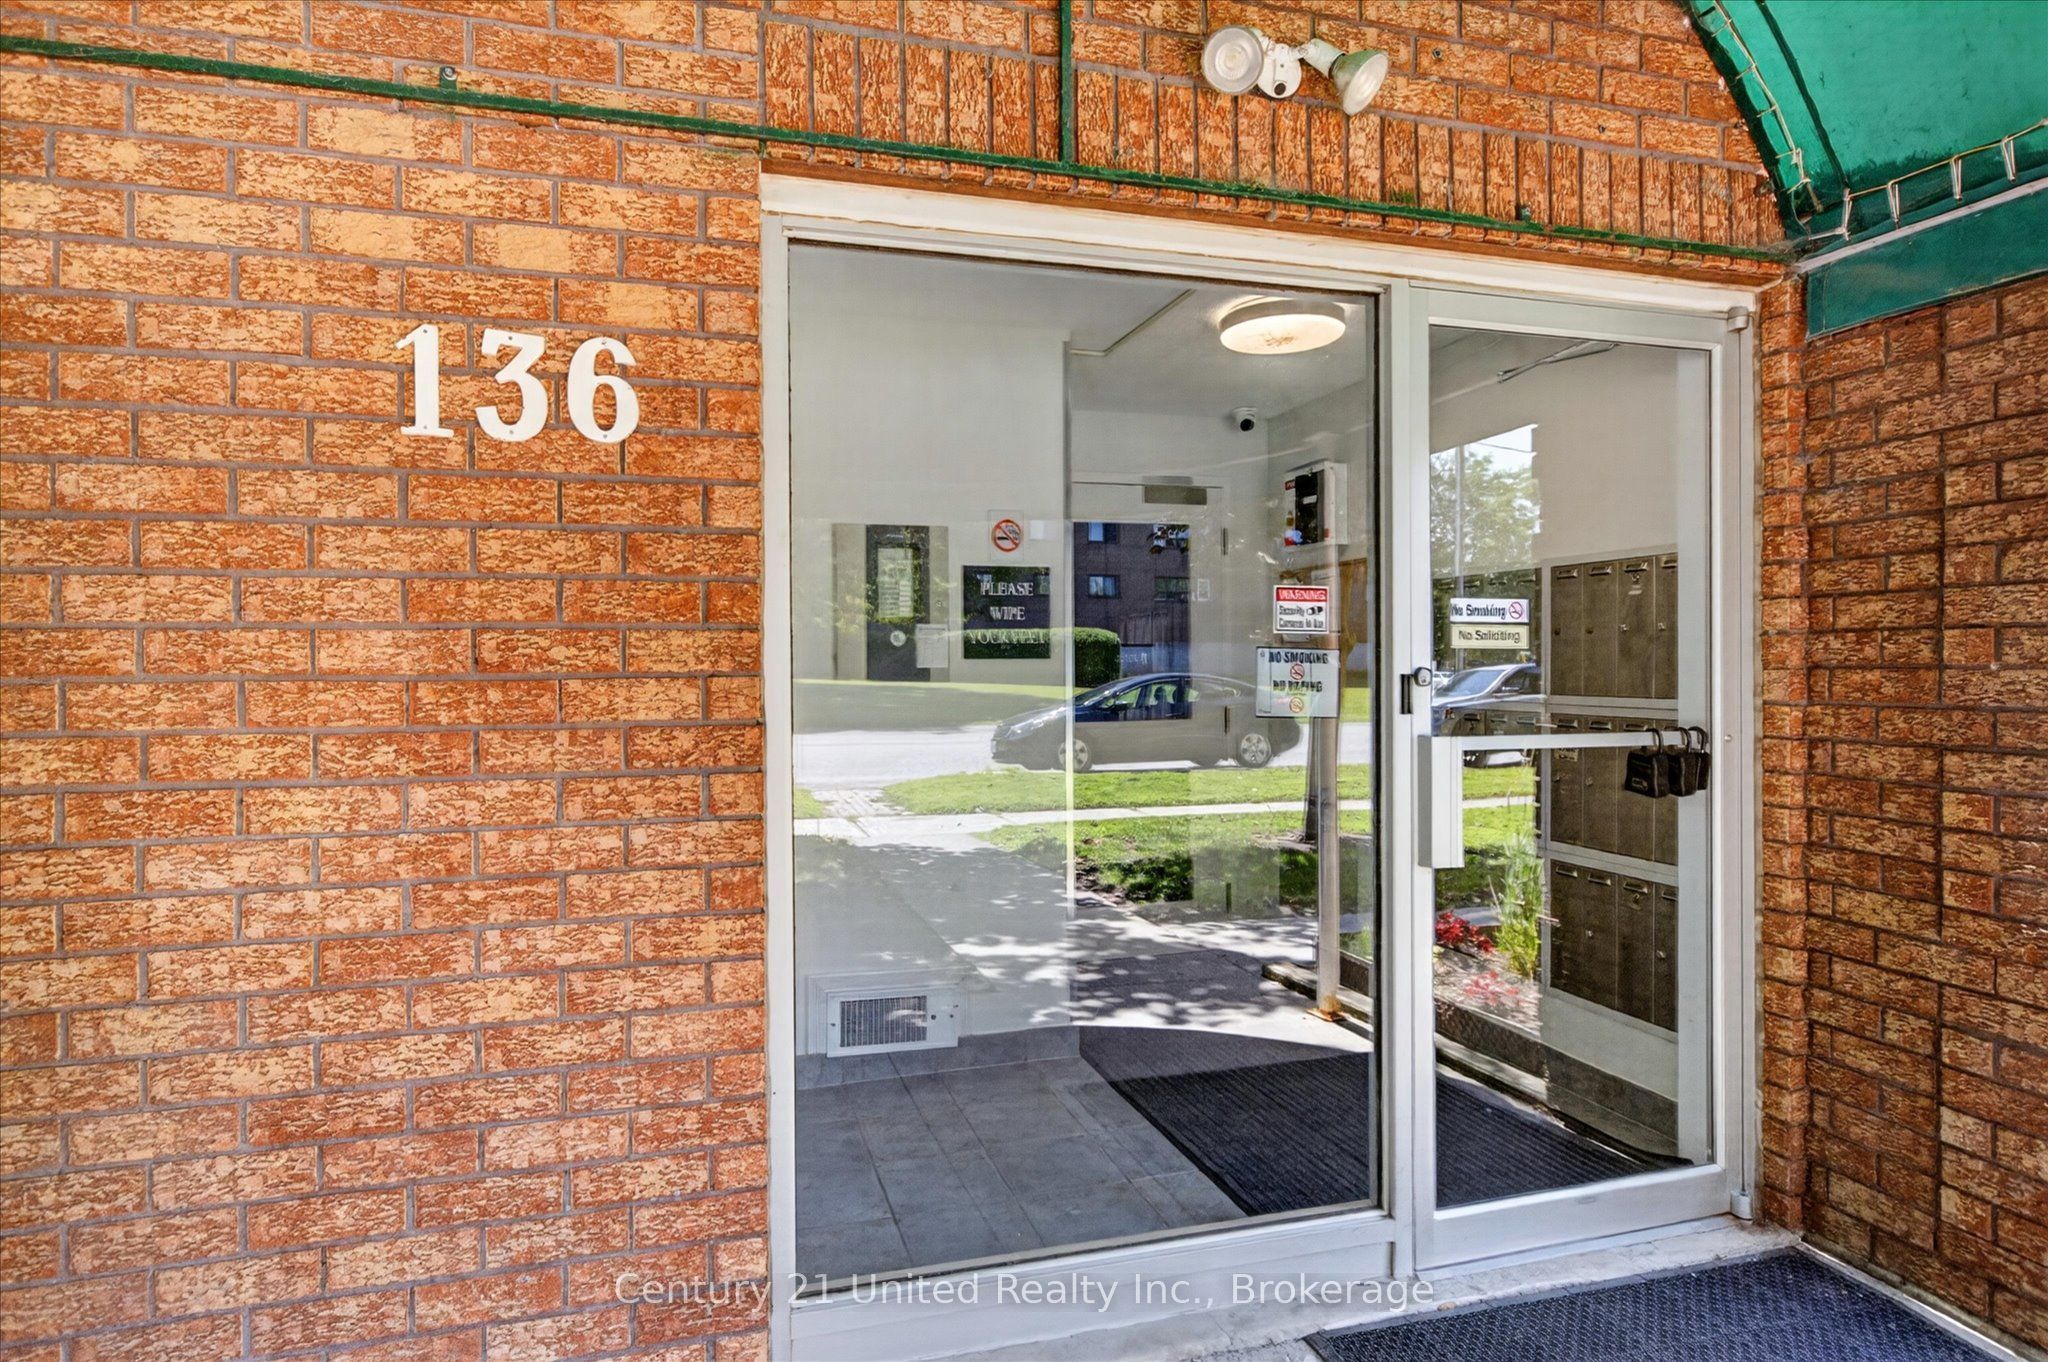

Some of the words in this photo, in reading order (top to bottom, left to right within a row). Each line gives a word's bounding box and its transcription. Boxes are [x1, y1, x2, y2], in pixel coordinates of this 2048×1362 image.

[395, 324, 640, 443] 136
[980, 582, 1034, 596] PLEASE
[990, 606, 1026, 620] WIPE
[1451, 604, 1464, 616] No
[1466, 604, 1506, 620] Smoking
[1458, 630, 1472, 640] No
[1269, 651, 1282, 663] NO
[1284, 651, 1329, 664] SMOKING
